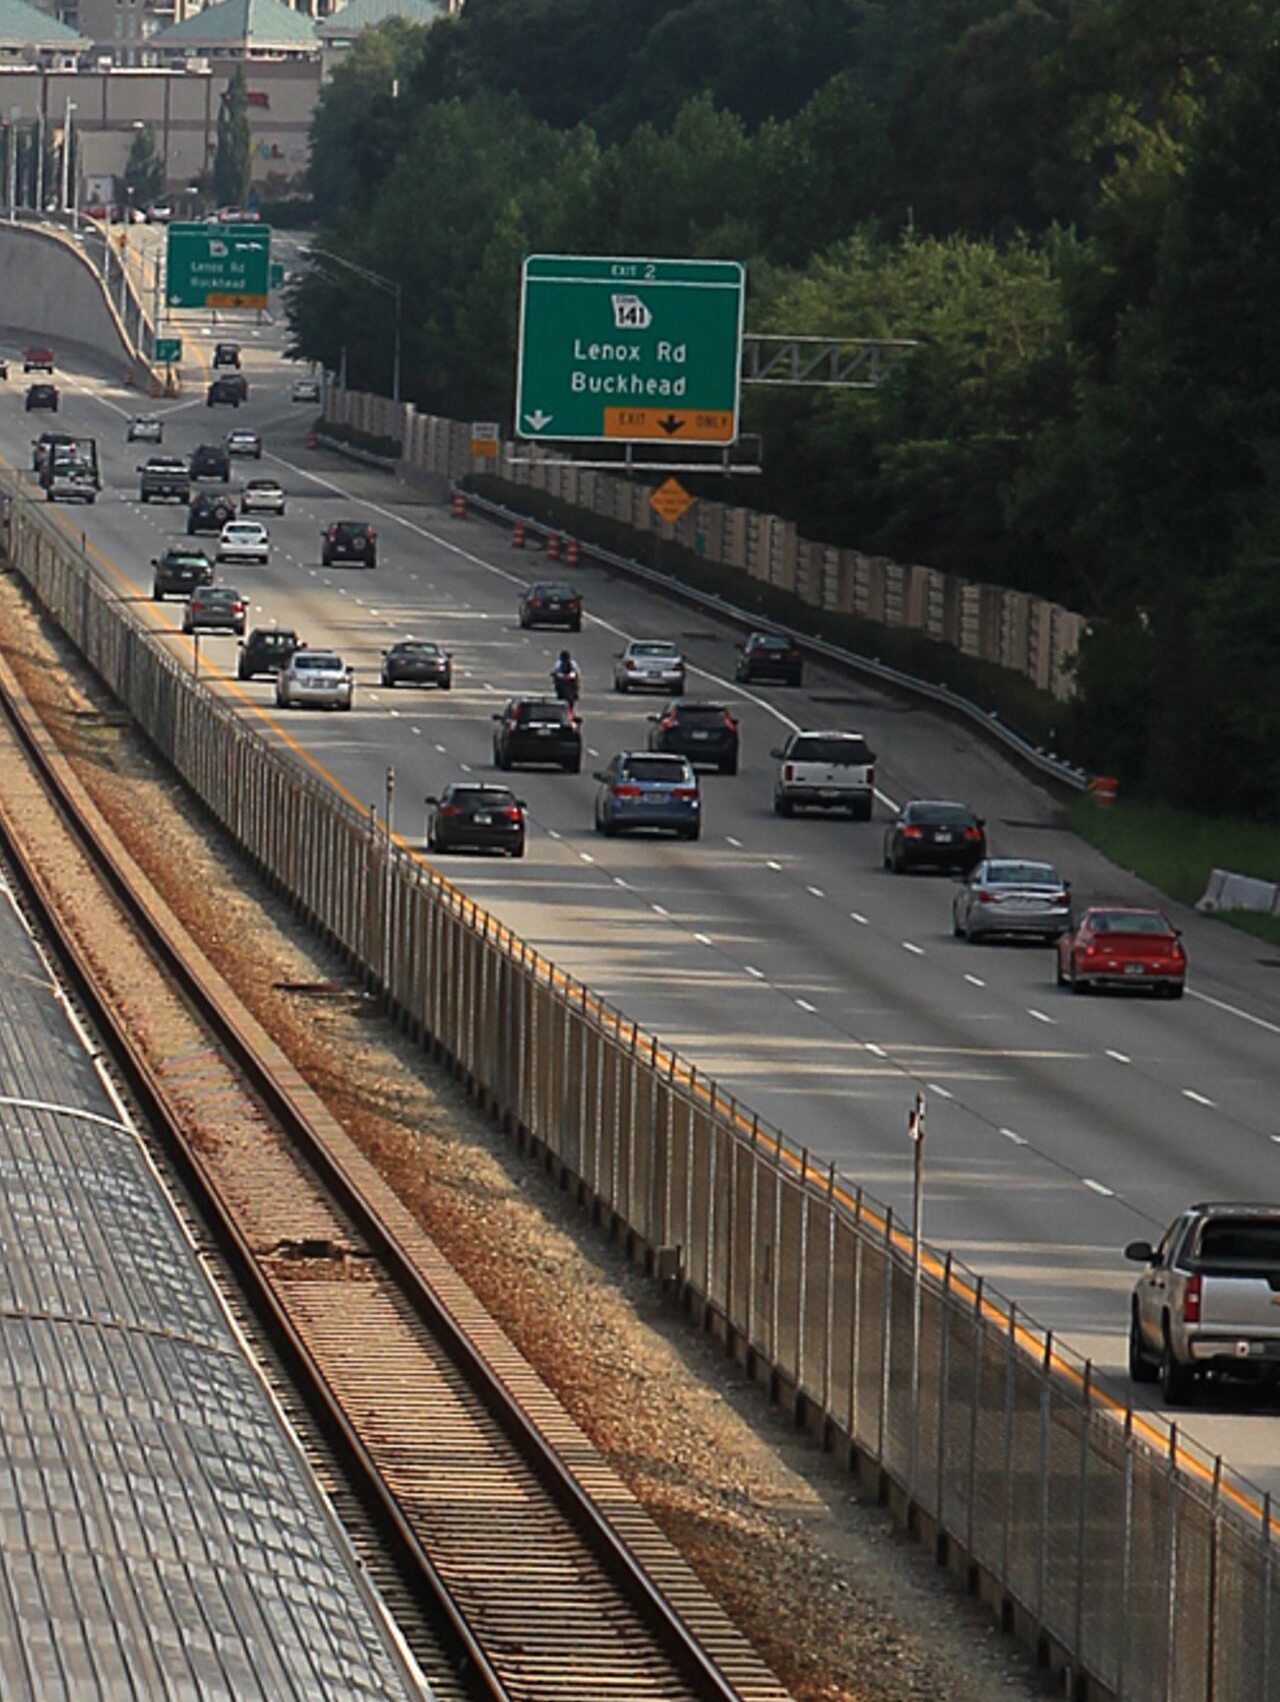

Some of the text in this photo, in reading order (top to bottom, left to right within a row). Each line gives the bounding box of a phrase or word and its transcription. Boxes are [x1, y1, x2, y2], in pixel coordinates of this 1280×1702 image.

[610, 264, 656, 279] EXIT 2
[618, 305, 645, 324] 141
[573, 338, 686, 363] Lenox Rd
[571, 371, 686, 396] Buckhead
[618, 411, 727, 429] EXIT ONLY
